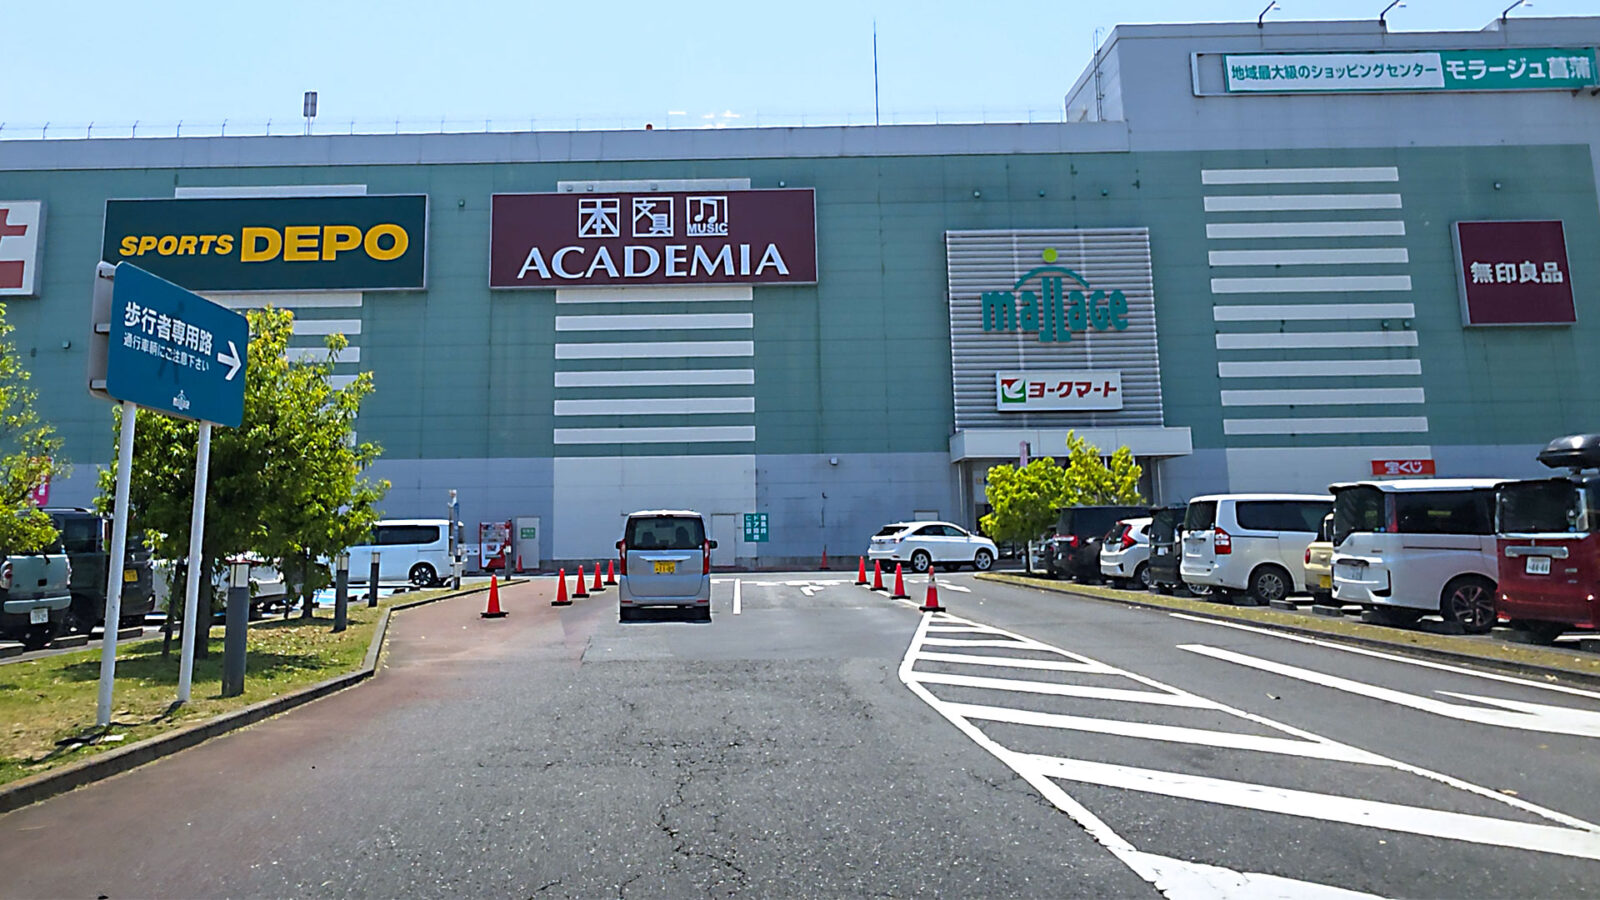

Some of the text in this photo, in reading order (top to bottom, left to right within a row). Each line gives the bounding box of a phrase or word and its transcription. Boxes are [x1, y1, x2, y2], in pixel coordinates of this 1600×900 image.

[1231, 63, 1438, 81] 地域最大級のショッピングセンター
[686, 222, 729, 234] MUSIC
[119, 223, 410, 262] SPORTS DEPO
[517, 243, 790, 279] ACADEMIA
[1470, 260, 1564, 284] 無印良品
[124, 301, 213, 356] 歩行者専用路
[1028, 381, 1118, 399] ヨークマート
[1384, 461, 1423, 475] 宝くじ
